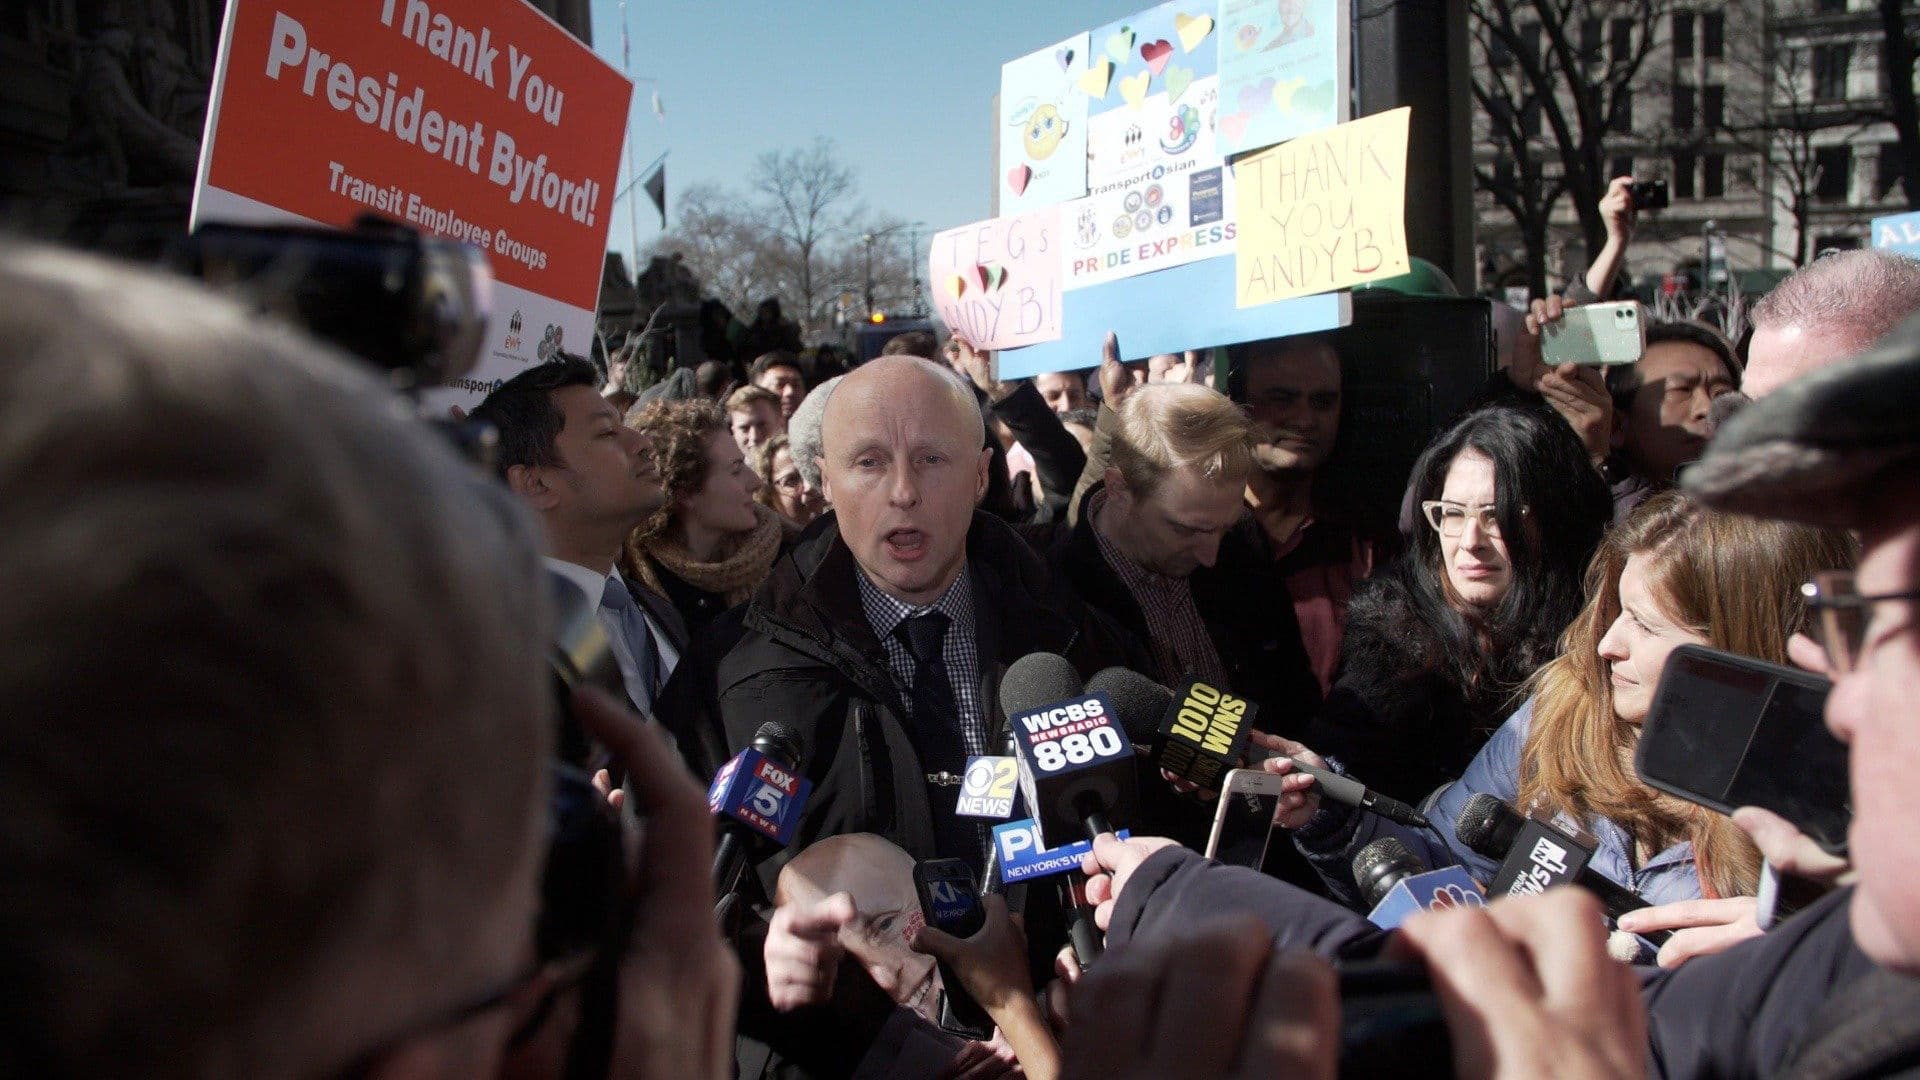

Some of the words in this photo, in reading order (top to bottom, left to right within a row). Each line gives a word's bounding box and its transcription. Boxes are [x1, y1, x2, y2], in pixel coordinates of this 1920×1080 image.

[507, 44, 564, 126] You
[265, 10, 485, 176] President
[488, 130, 600, 227] Byford!
[1243, 139, 1393, 208] THANK
[328, 160, 403, 217] Transit
[405, 195, 491, 249] Employee
[495, 229, 548, 271] Groups
[1271, 200, 1354, 239] YOU
[1073, 249, 1131, 276] PRIDE
[1138, 223, 1237, 260] EXPRESS
[1247, 238, 1346, 294] ANDY
[1021, 699, 1104, 734] WCBS
[1029, 716, 1108, 743] NEWSRADIO
[1171, 682, 1220, 742] 1010
[1201, 694, 1247, 755] WINS
[1033, 726, 1122, 771] 880
[760, 763, 795, 792] FOX
[988, 757, 1019, 798] 2
[740, 808, 777, 832] NEWS
[753, 783, 784, 817] 5
[959, 797, 1010, 815] NEWS
[1007, 865, 1031, 878] NEW
[1031, 855, 1070, 873] YORK'S
[1534, 841, 1551, 860] NY
[1520, 864, 1551, 894] WS
